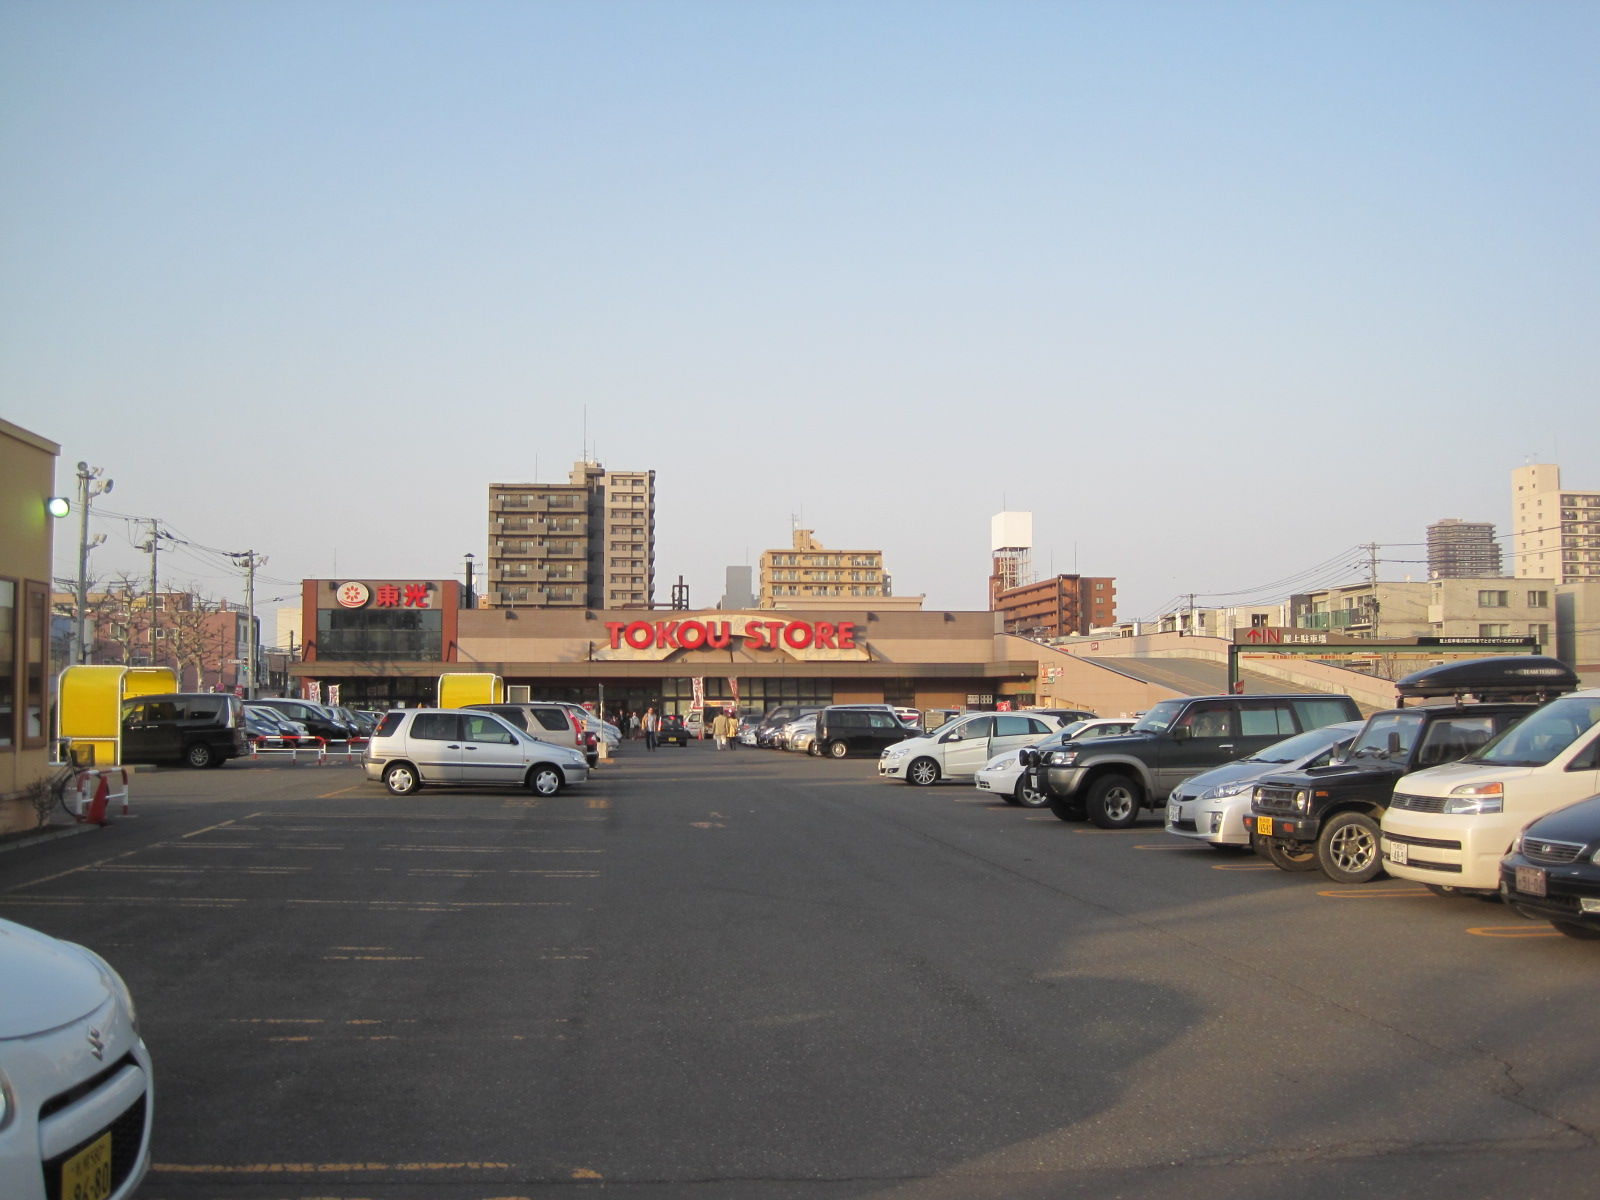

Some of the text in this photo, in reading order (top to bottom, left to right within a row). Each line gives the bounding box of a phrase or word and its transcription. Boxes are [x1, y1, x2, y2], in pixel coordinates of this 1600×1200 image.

[376, 583, 430, 608] 東光
[603, 619, 856, 651] TOKOU STORE
[1261, 628, 1282, 644] IN
[1283, 633, 1327, 644] 屋上駐車場
